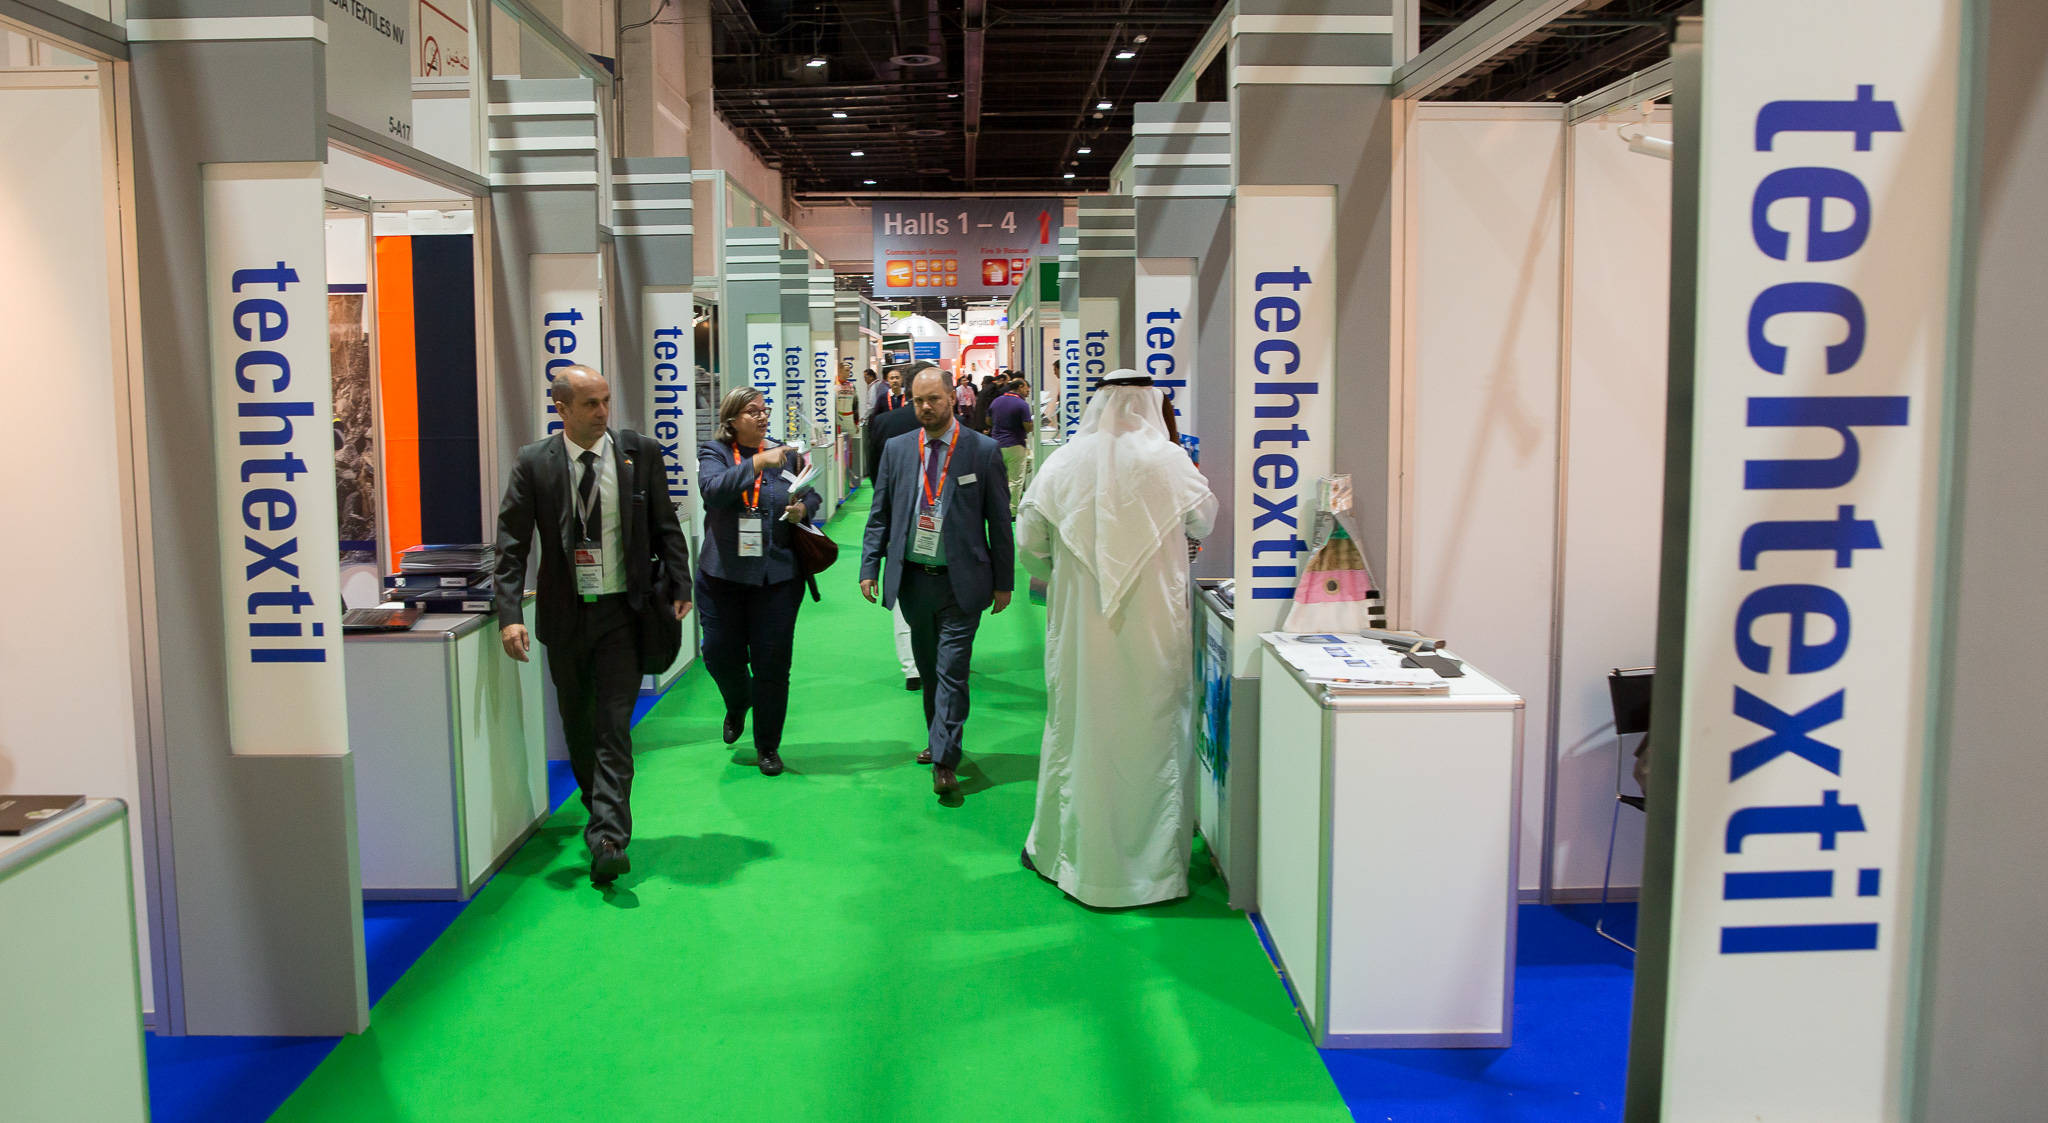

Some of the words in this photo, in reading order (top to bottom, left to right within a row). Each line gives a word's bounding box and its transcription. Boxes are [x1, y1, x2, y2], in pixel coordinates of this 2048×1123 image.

[350, 0, 392, 37] TEXTILES
[392, 24, 405, 45] NV
[389, 116, 411, 141] 5-A17
[884, 212, 950, 236] Halls
[957, 211, 969, 235] 1
[1000, 211, 1018, 234] 4
[949, 312, 960, 331] UK
[1146, 308, 1187, 417] tech
[231, 260, 327, 663] techtextil
[1250, 265, 1319, 600] techtextil
[1720, 83, 1911, 955] techtextil
